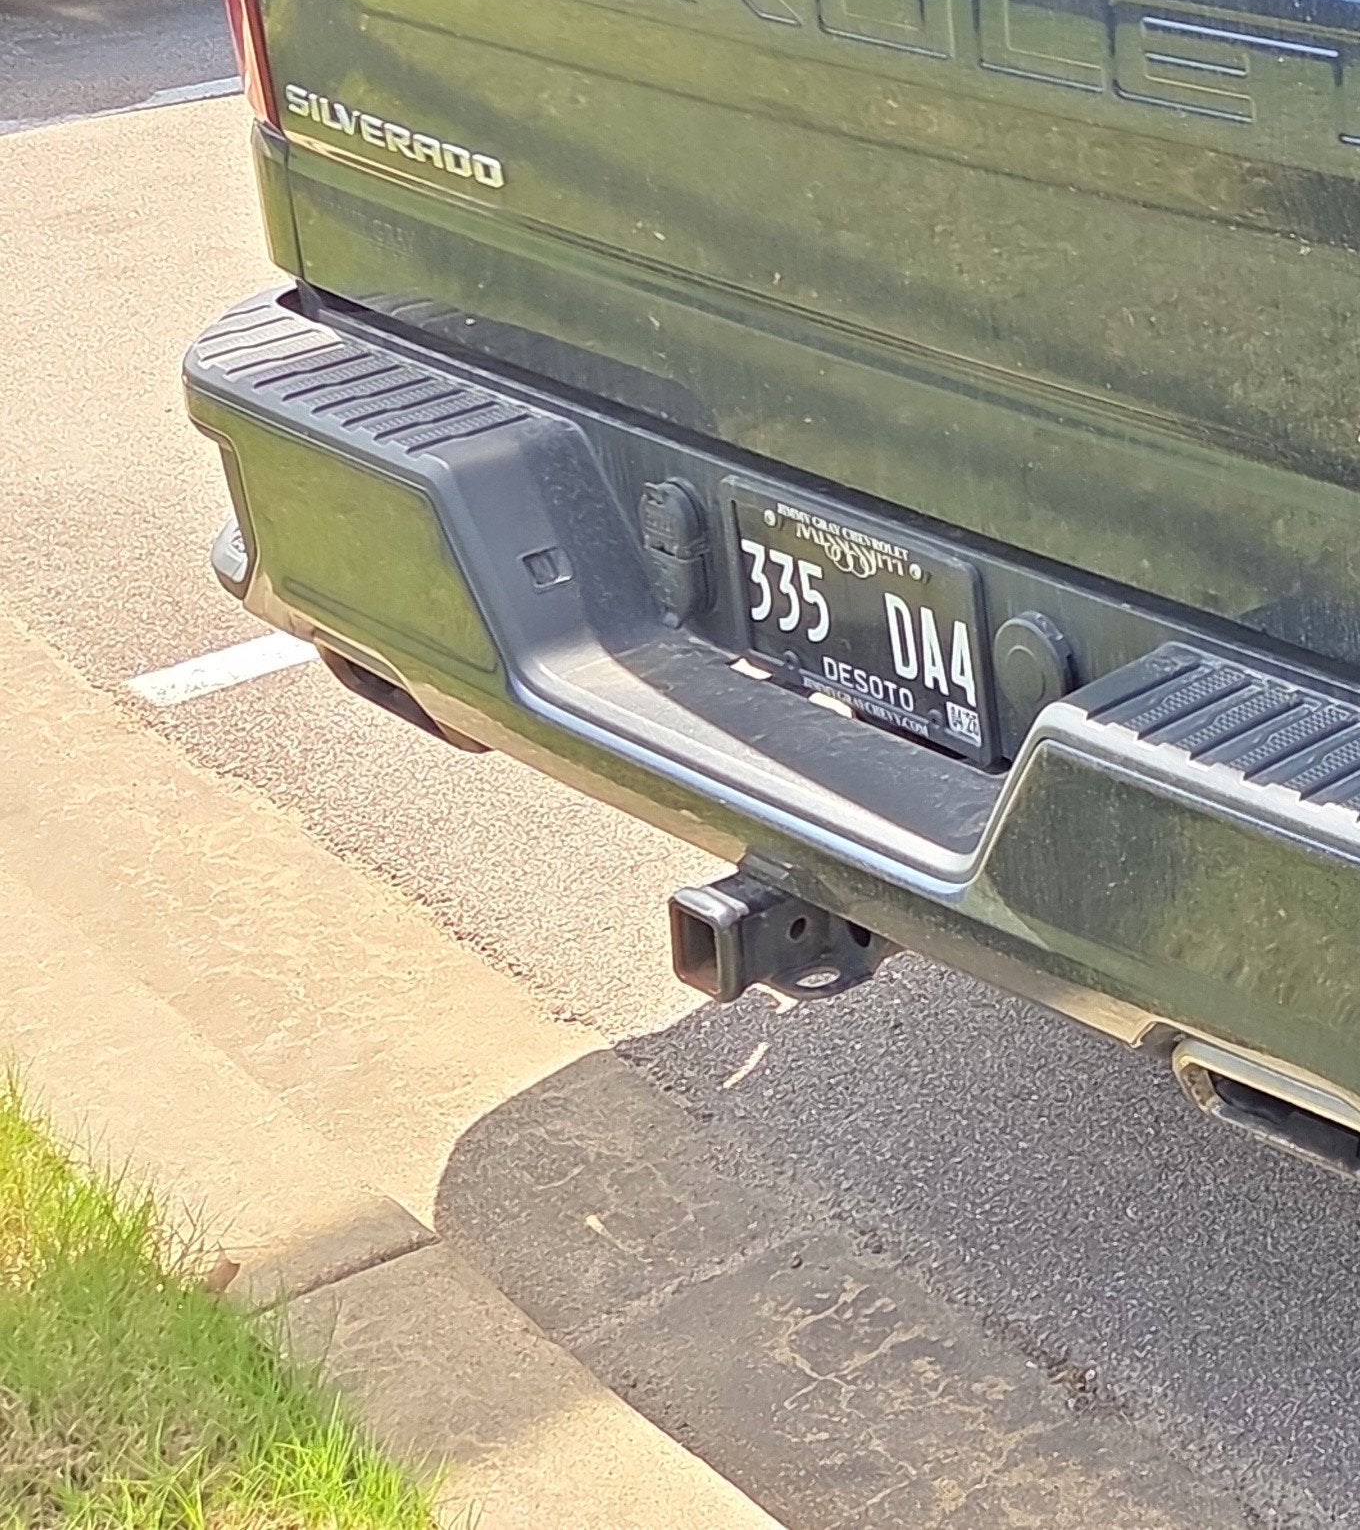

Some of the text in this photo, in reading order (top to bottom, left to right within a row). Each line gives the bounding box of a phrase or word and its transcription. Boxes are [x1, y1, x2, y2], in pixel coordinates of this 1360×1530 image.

[285, 84, 505, 189] SILVERADO
[811, 516, 841, 537] GRAY
[841, 526, 909, 562] CHEVROLET
[740, 538, 977, 708] 335 DA4
[822, 655, 915, 713] DESOTO
